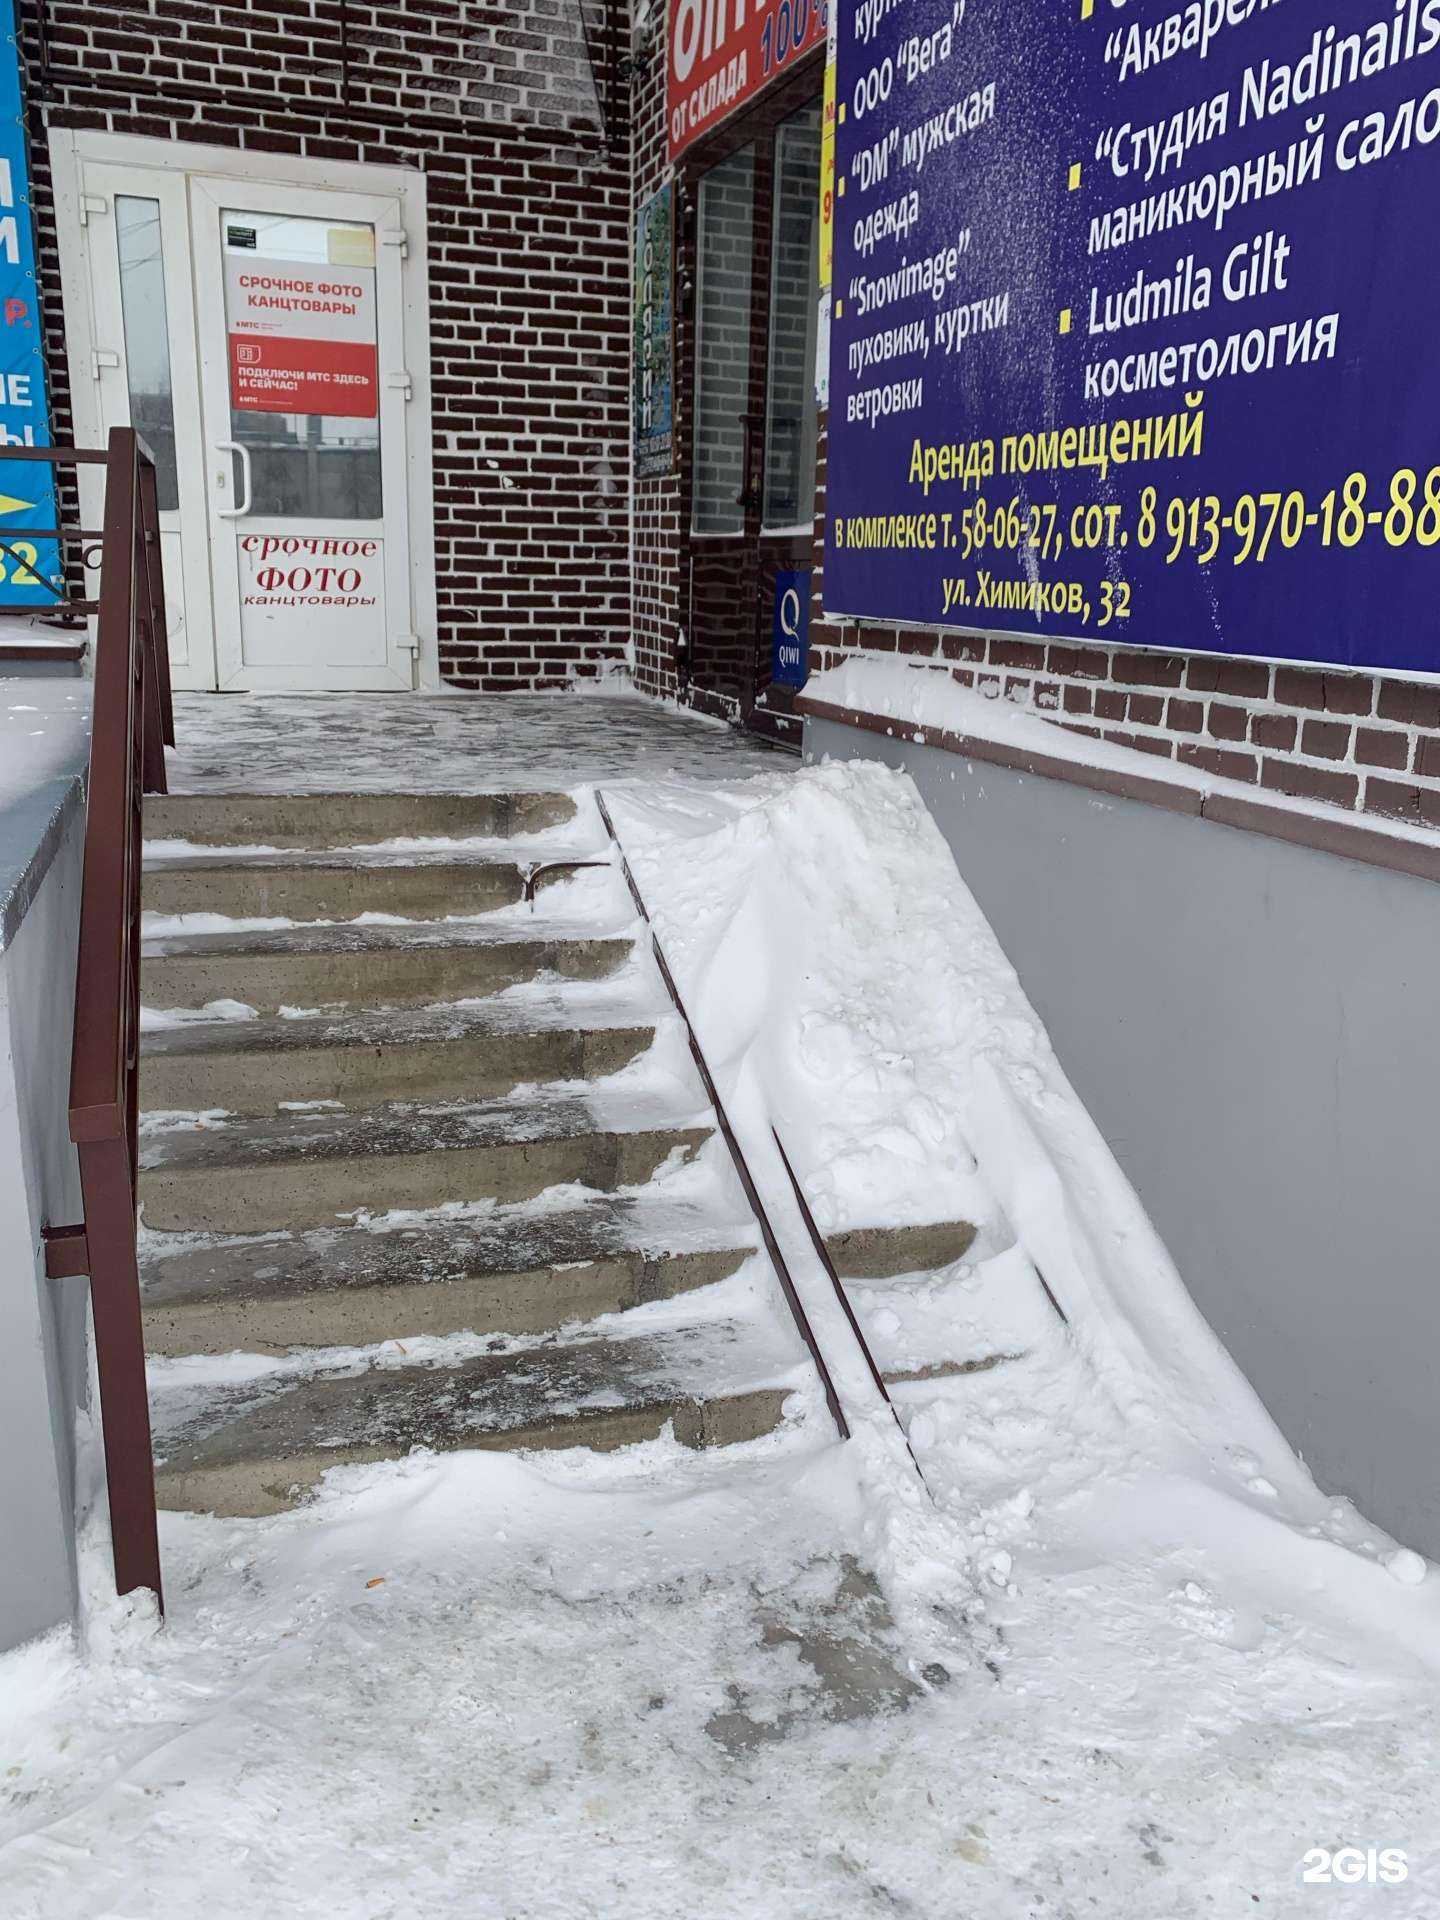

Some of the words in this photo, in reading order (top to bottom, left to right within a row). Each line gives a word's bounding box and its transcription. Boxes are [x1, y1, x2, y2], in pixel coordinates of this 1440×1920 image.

[853, 57, 893, 120] ООО
[897, 0, 966, 84] “Вега”
[1104, 0, 1284, 82] “Акваре
[671, 99, 688, 143] ОТ
[689, 49, 748, 128] СКЛАДА
[902, 81, 996, 173] мужская
[1095, 91, 1230, 182] “Студия
[854, 190, 919, 258] одежда
[1088, 113, 1326, 255] маникюрный
[239, 275, 314, 294] СРОЧНОЕ
[318, 283, 363, 298] ФОТО
[247, 295, 356, 315] КАНЦТОВАРЫ
[849, 227, 970, 316] “Snowimage”
[1089, 254, 1212, 335] Ludmila
[1222, 230, 1291, 302] Gilt
[238, 367, 305, 380] ПОДКЛЮЧИ
[307, 371, 331, 382] МТС
[333, 373, 369, 385] ЗДЕСЬ
[848, 319, 930, 380] пуховики,
[934, 291, 1009, 355] куртки
[1084, 312, 1340, 400] косметология
[238, 379, 248, 388] И
[249, 379, 298, 391] СЕЙЧАС!
[847, 377, 923, 429] ветровки
[909, 438, 994, 496] Аренда
[1001, 390, 1204, 480] помещений
[241, 536, 377, 561] срочное
[835, 518, 843, 548] в
[846, 512, 937, 550] комплексе
[941, 513, 957, 548] т.
[961, 496, 1063, 561] 58-06-27,
[1070, 504, 1128, 548] сот.
[1137, 486, 1157, 548] 8
[1166, 465, 1440, 565] 913-970-18-88
[244, 595, 376, 607] канцтовары
[256, 567, 362, 592] ФОТО
[942, 578, 971, 615] ул.
[974, 571, 1091, 625] Химиков,
[1097, 580, 1131, 626] 32
[779, 645, 800, 668] QIWI
